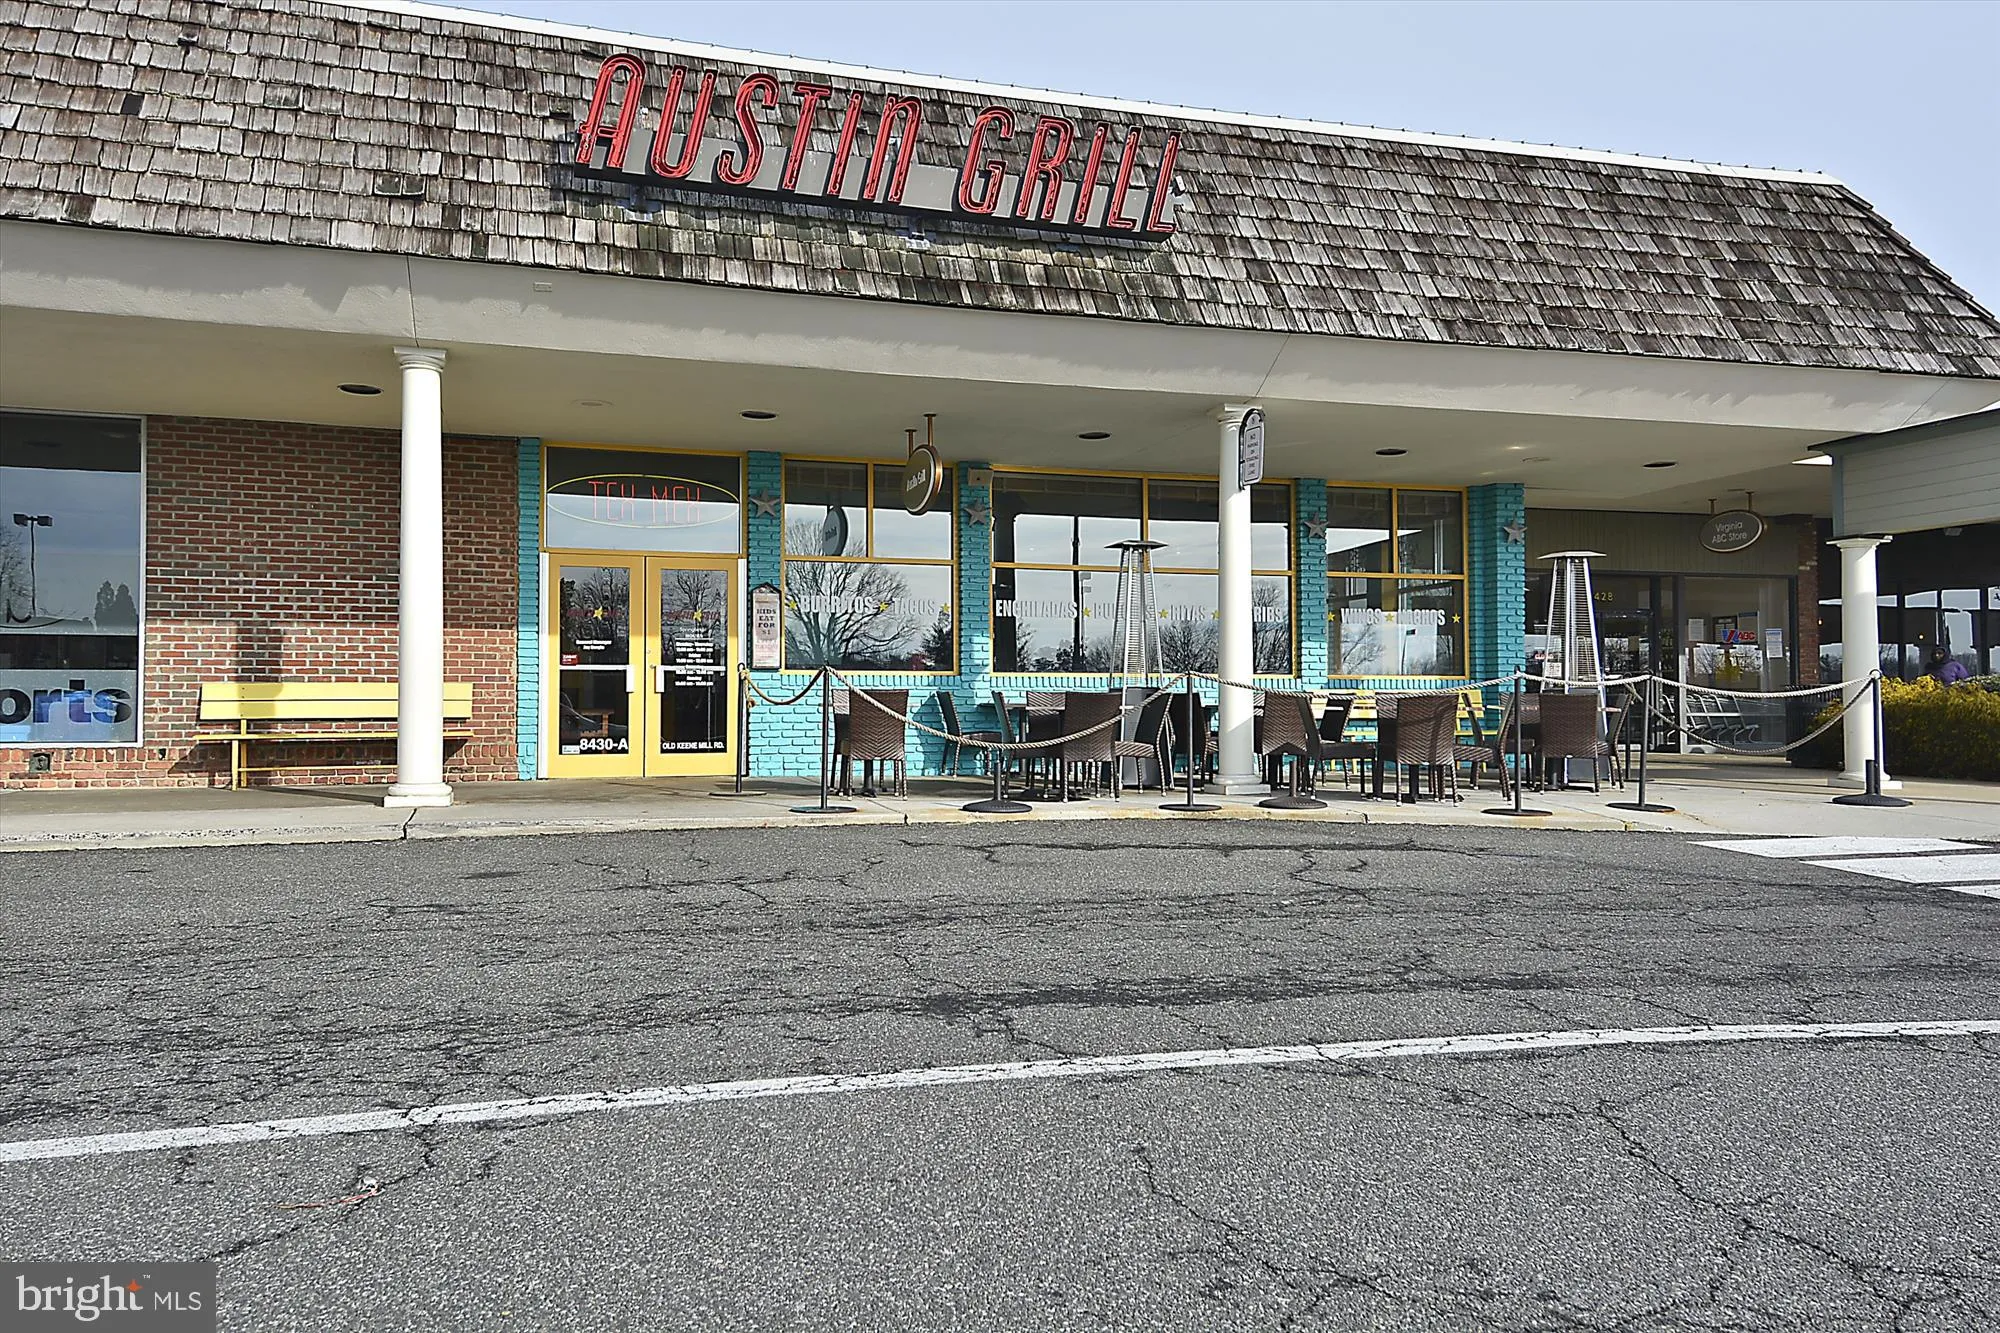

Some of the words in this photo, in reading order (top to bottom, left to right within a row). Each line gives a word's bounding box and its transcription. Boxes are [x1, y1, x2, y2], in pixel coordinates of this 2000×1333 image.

[577, 52, 923, 204] AUSTIN
[958, 105, 1182, 233] GRILL
[588, 480, 635, 521] TEX
[652, 484, 701, 524] MEX
[1715, 521, 1743, 533] Virginia
[1712, 533, 1727, 544] ABC
[1728, 532, 1747, 542] Store
[800, 595, 873, 614] BURRITOS
[893, 597, 935, 616] TACOS
[995, 599, 1078, 619] ENCHILADAS
[1253, 606, 1282, 623] RIBS
[1340, 607, 1382, 625] WINGS
[1396, 608, 1446, 626] NACHOS
[1738, 630, 1756, 640] ABC
[579, 738, 629, 750] 8430-A
[662, 741, 675, 750] OLD
[676, 741, 698, 749] KEENE
